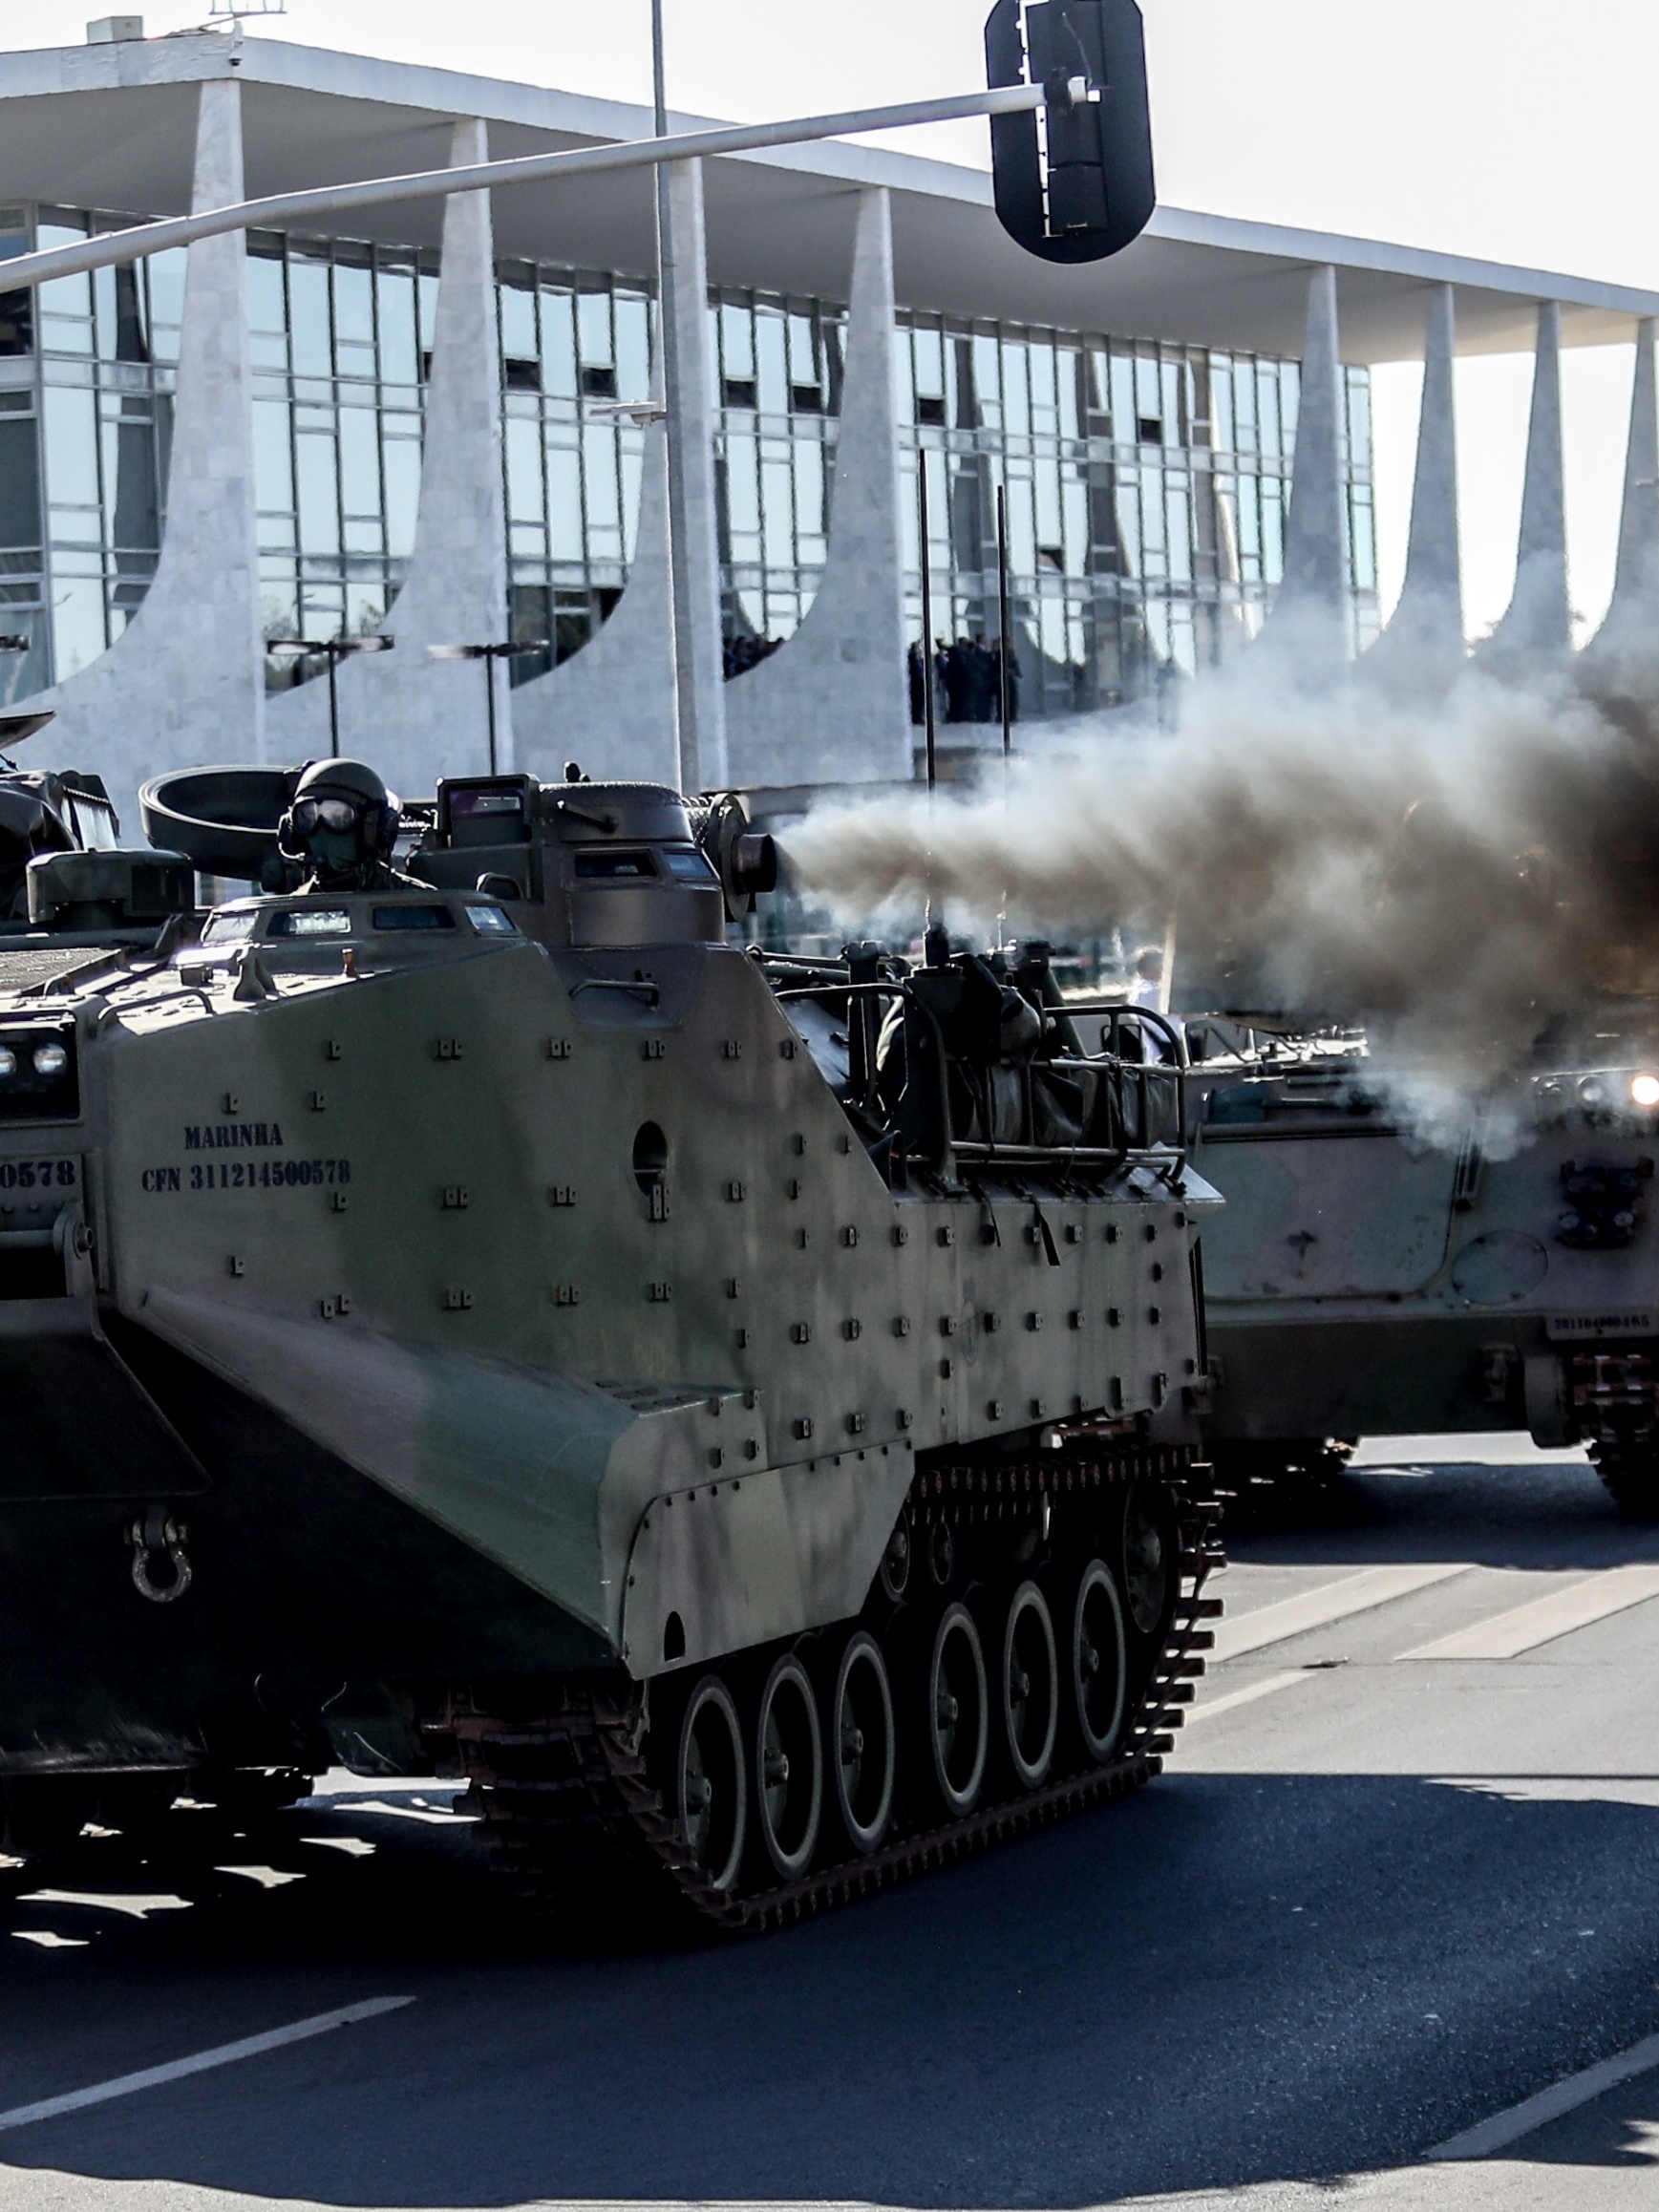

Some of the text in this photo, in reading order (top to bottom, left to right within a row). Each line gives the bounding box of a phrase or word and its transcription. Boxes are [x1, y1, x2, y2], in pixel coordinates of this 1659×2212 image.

[184, 1123, 284, 1150] MARINHA
[141, 1159, 351, 1192] CFN 311214500578
